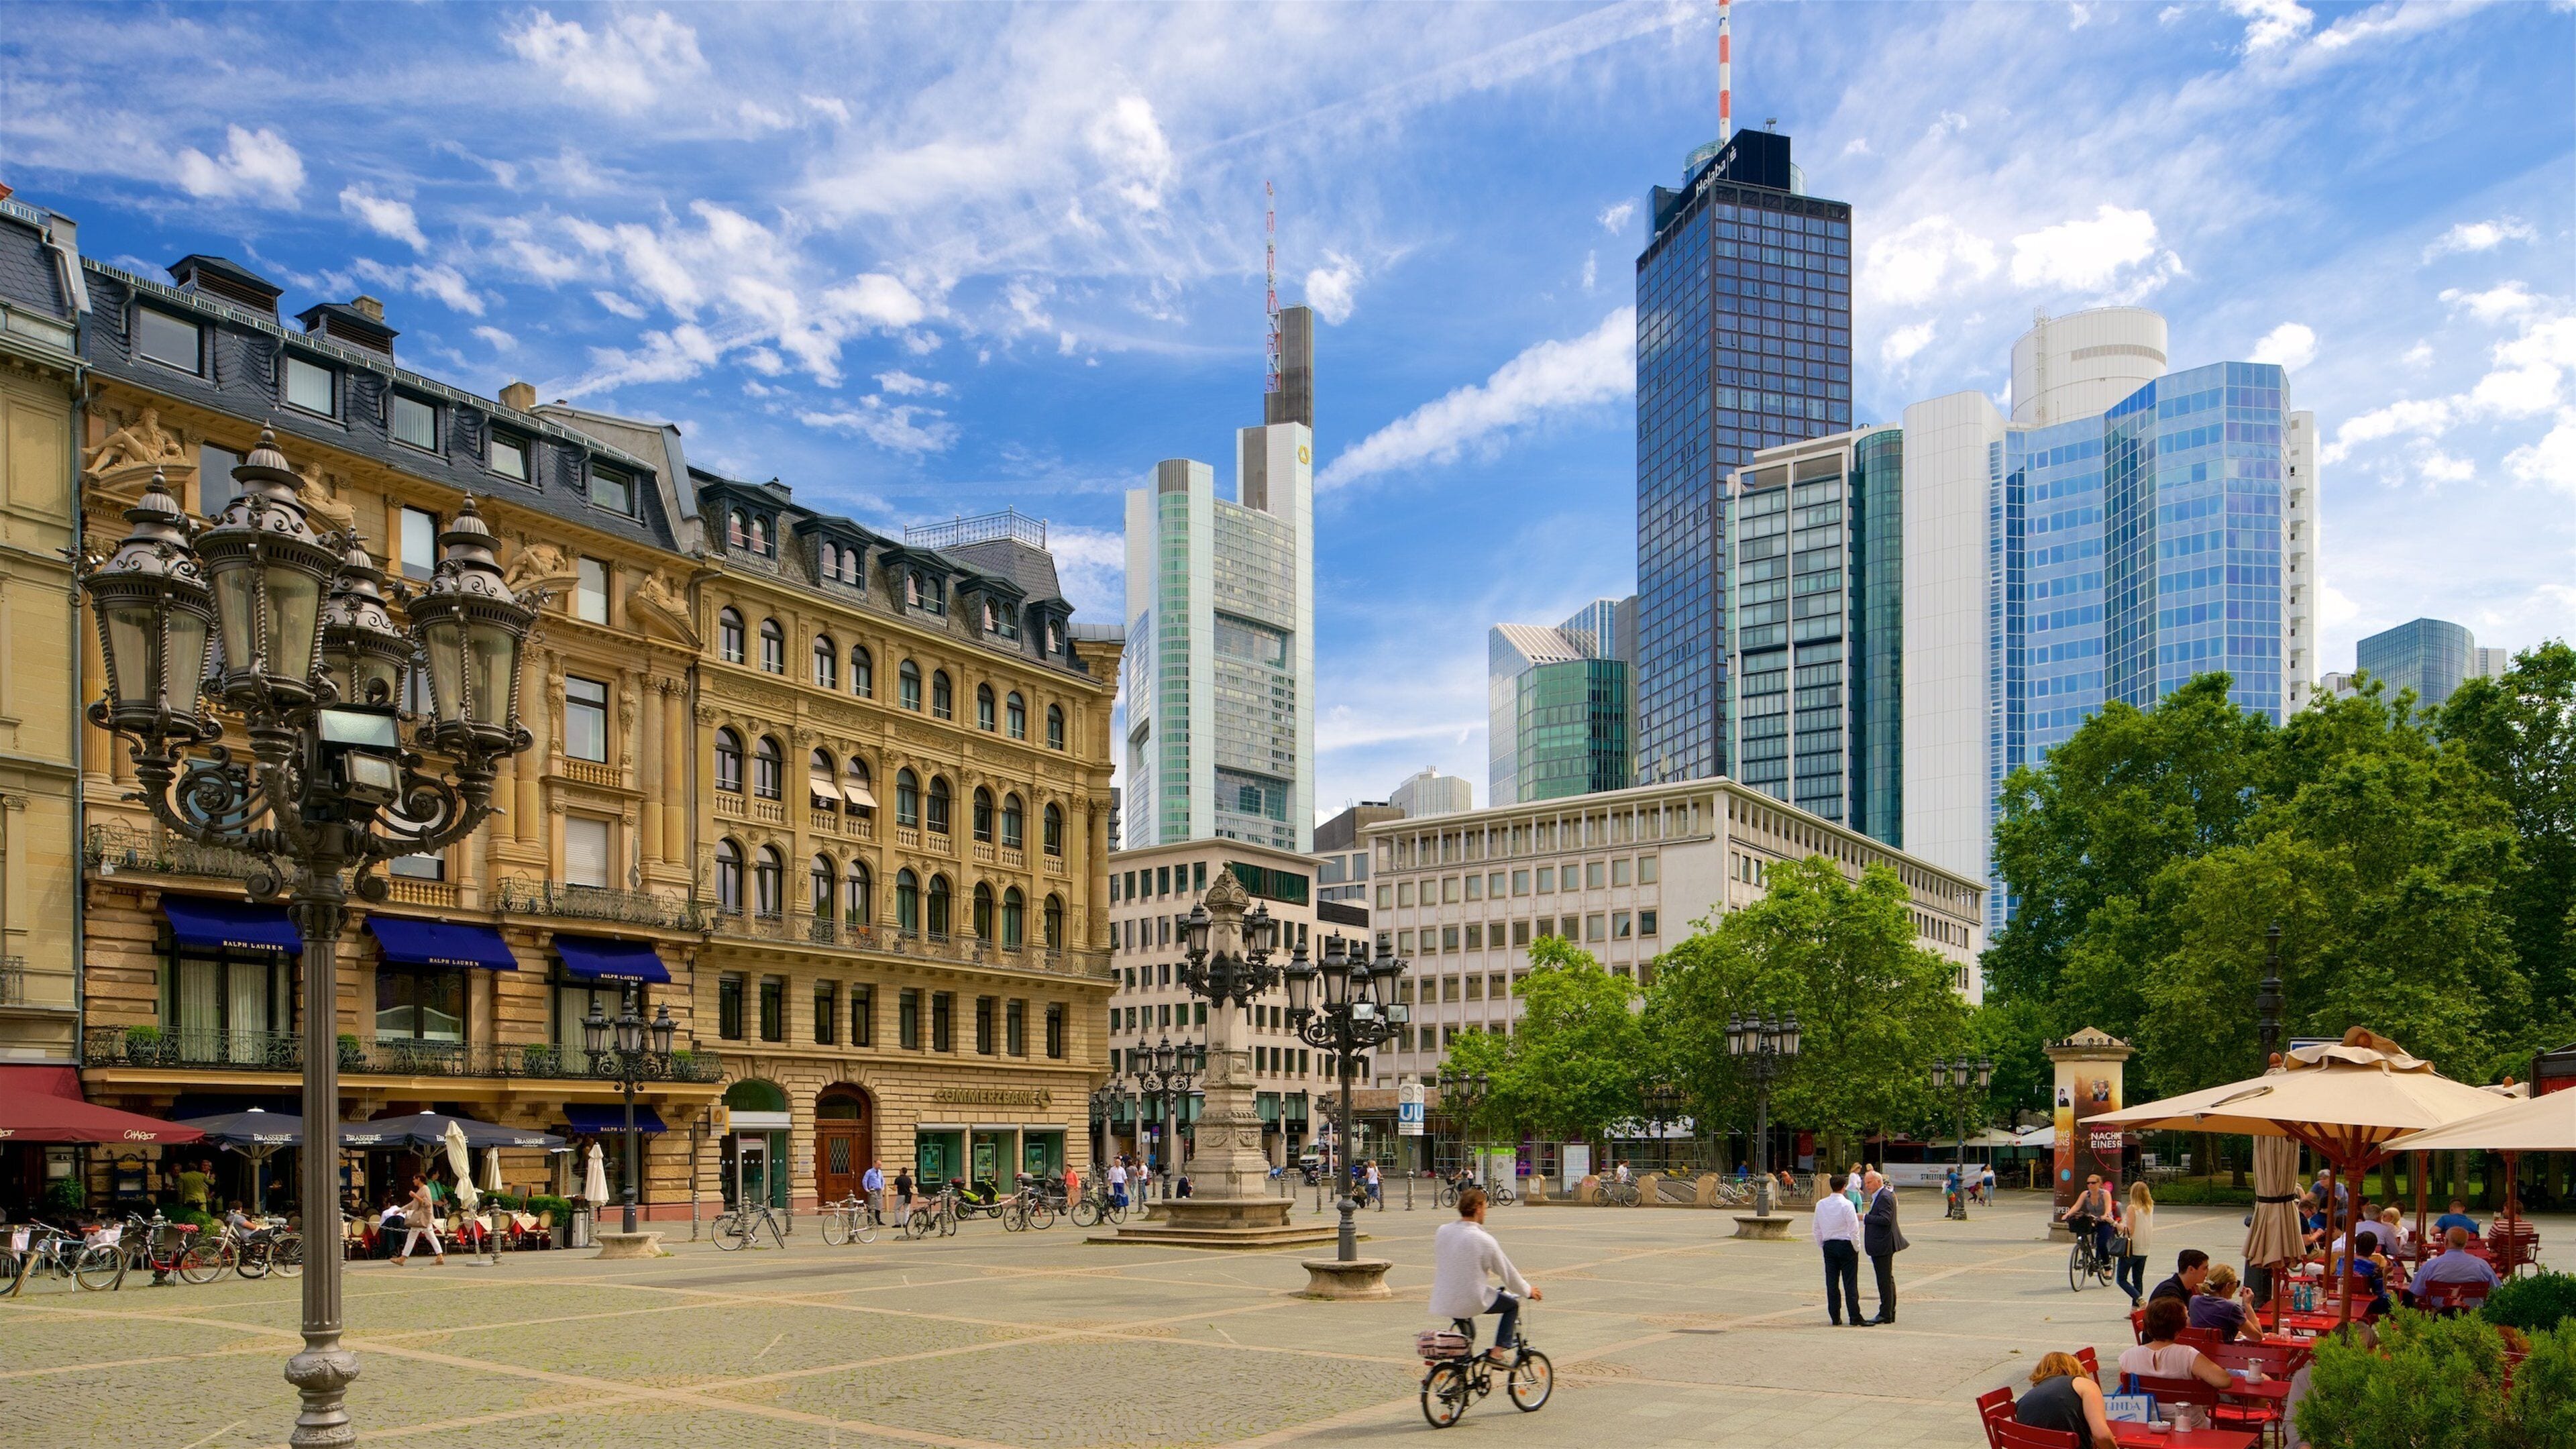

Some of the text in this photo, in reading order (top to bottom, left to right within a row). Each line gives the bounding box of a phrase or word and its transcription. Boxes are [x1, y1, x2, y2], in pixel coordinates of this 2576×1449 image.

[1695, 160, 1726, 197] Helaba
[935, 1089, 1036, 1105] COMMERZBANK
[1400, 1105, 1414, 1121] U
[254, 1133, 292, 1141] BRASSERIE
